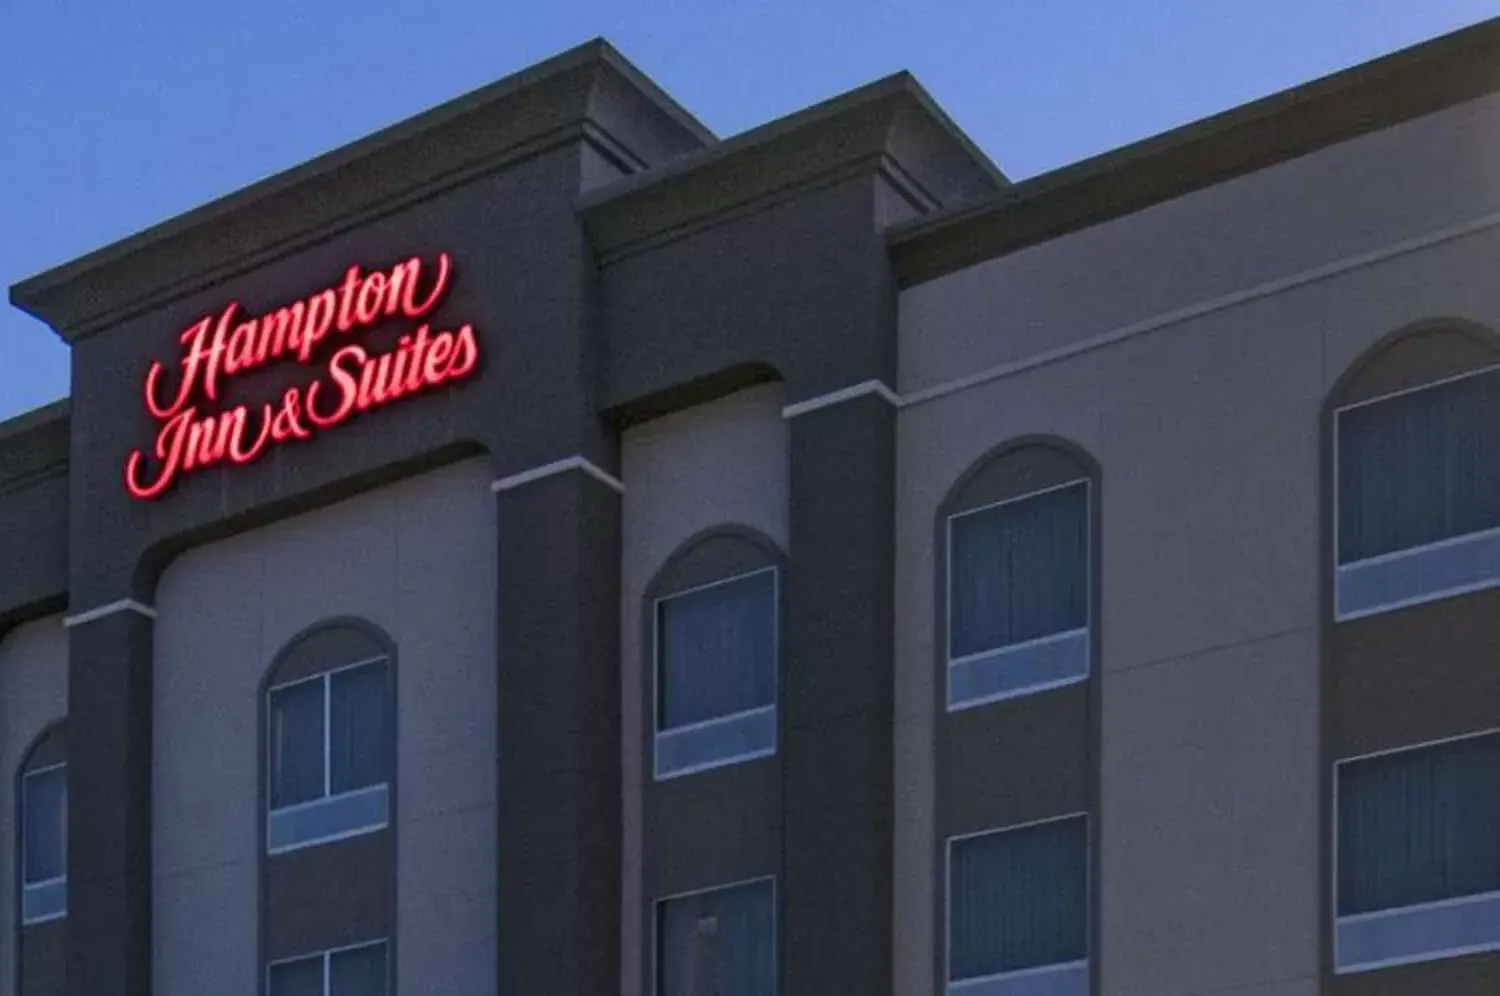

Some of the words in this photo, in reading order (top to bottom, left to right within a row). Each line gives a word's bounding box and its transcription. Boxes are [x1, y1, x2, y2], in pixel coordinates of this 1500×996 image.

[126, 403, 272, 497] Inn
[272, 388, 310, 438] &
[306, 324, 478, 425] Suites
[145, 253, 450, 418] Hampton
